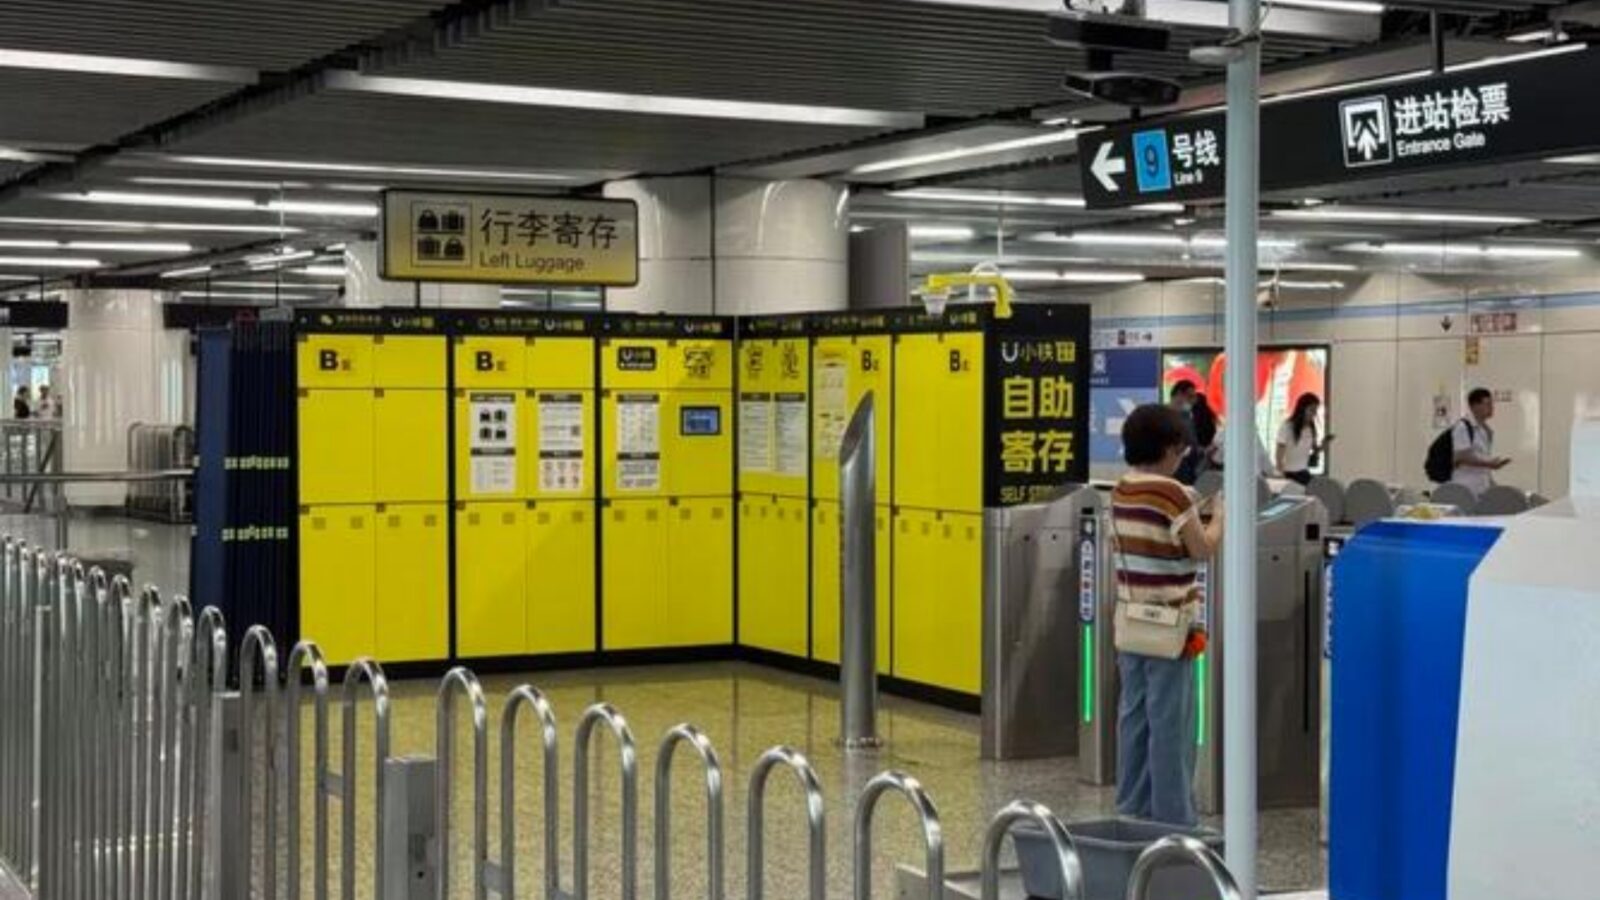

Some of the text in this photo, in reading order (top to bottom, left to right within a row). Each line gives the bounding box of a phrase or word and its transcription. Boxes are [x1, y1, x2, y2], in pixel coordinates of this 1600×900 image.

[1394, 82, 1510, 135] 进站检票
[1145, 129, 1220, 177] 9 号线
[1397, 132, 1486, 157] Entrance Gate
[1174, 168, 1203, 185] Line 9
[480, 208, 618, 249] 行李寄存
[480, 251, 585, 273] Left Luggage
[1004, 374, 1073, 419] 自助
[1000, 430, 1074, 473] 寄存
